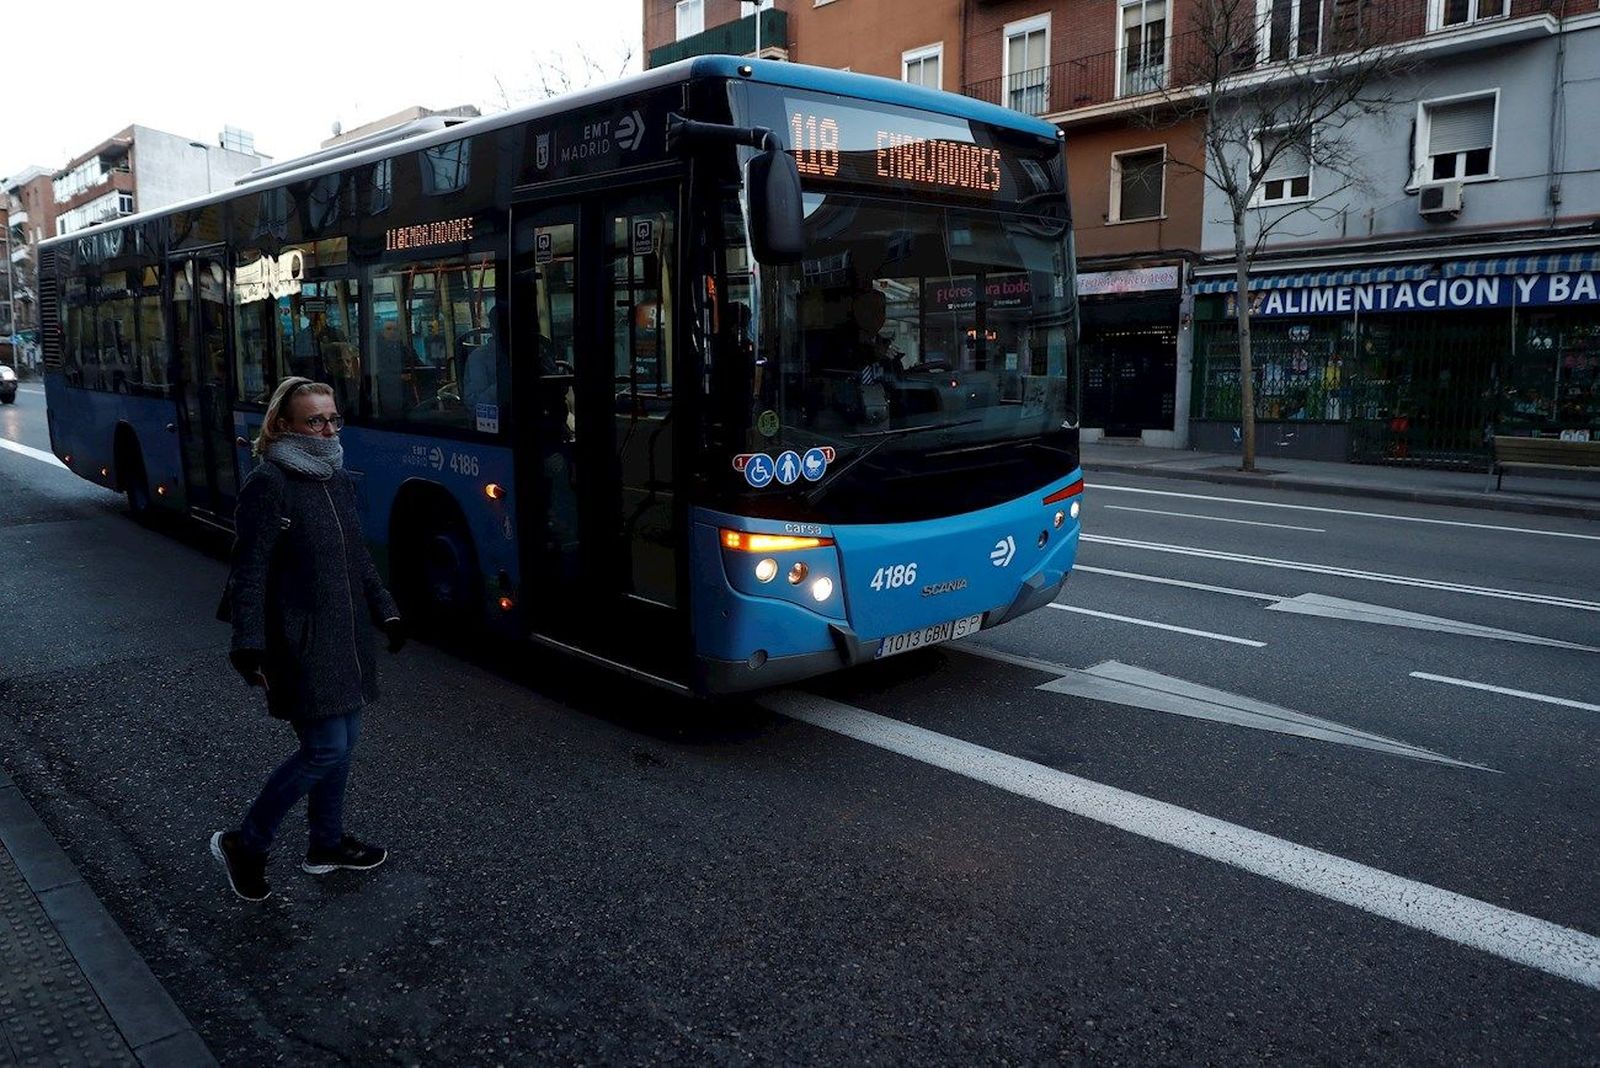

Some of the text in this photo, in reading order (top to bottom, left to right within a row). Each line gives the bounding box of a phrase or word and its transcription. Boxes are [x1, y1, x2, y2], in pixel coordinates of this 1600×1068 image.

[584, 121, 610, 139] EMT
[561, 139, 610, 161] MADRID
[791, 113, 1000, 191] 118 EMBAJADORES
[937, 286, 974, 302] Flores
[1002, 279, 1032, 295] todo
[1264, 272, 1600, 315] ALIMENTACION Y BA
[450, 452, 480, 477] 4186
[785, 523, 822, 534] carsa
[870, 562, 918, 592] 4186
[921, 578, 969, 598] SCANIA
[888, 631, 920, 653] 1013
[925, 623, 950, 643] GBN
